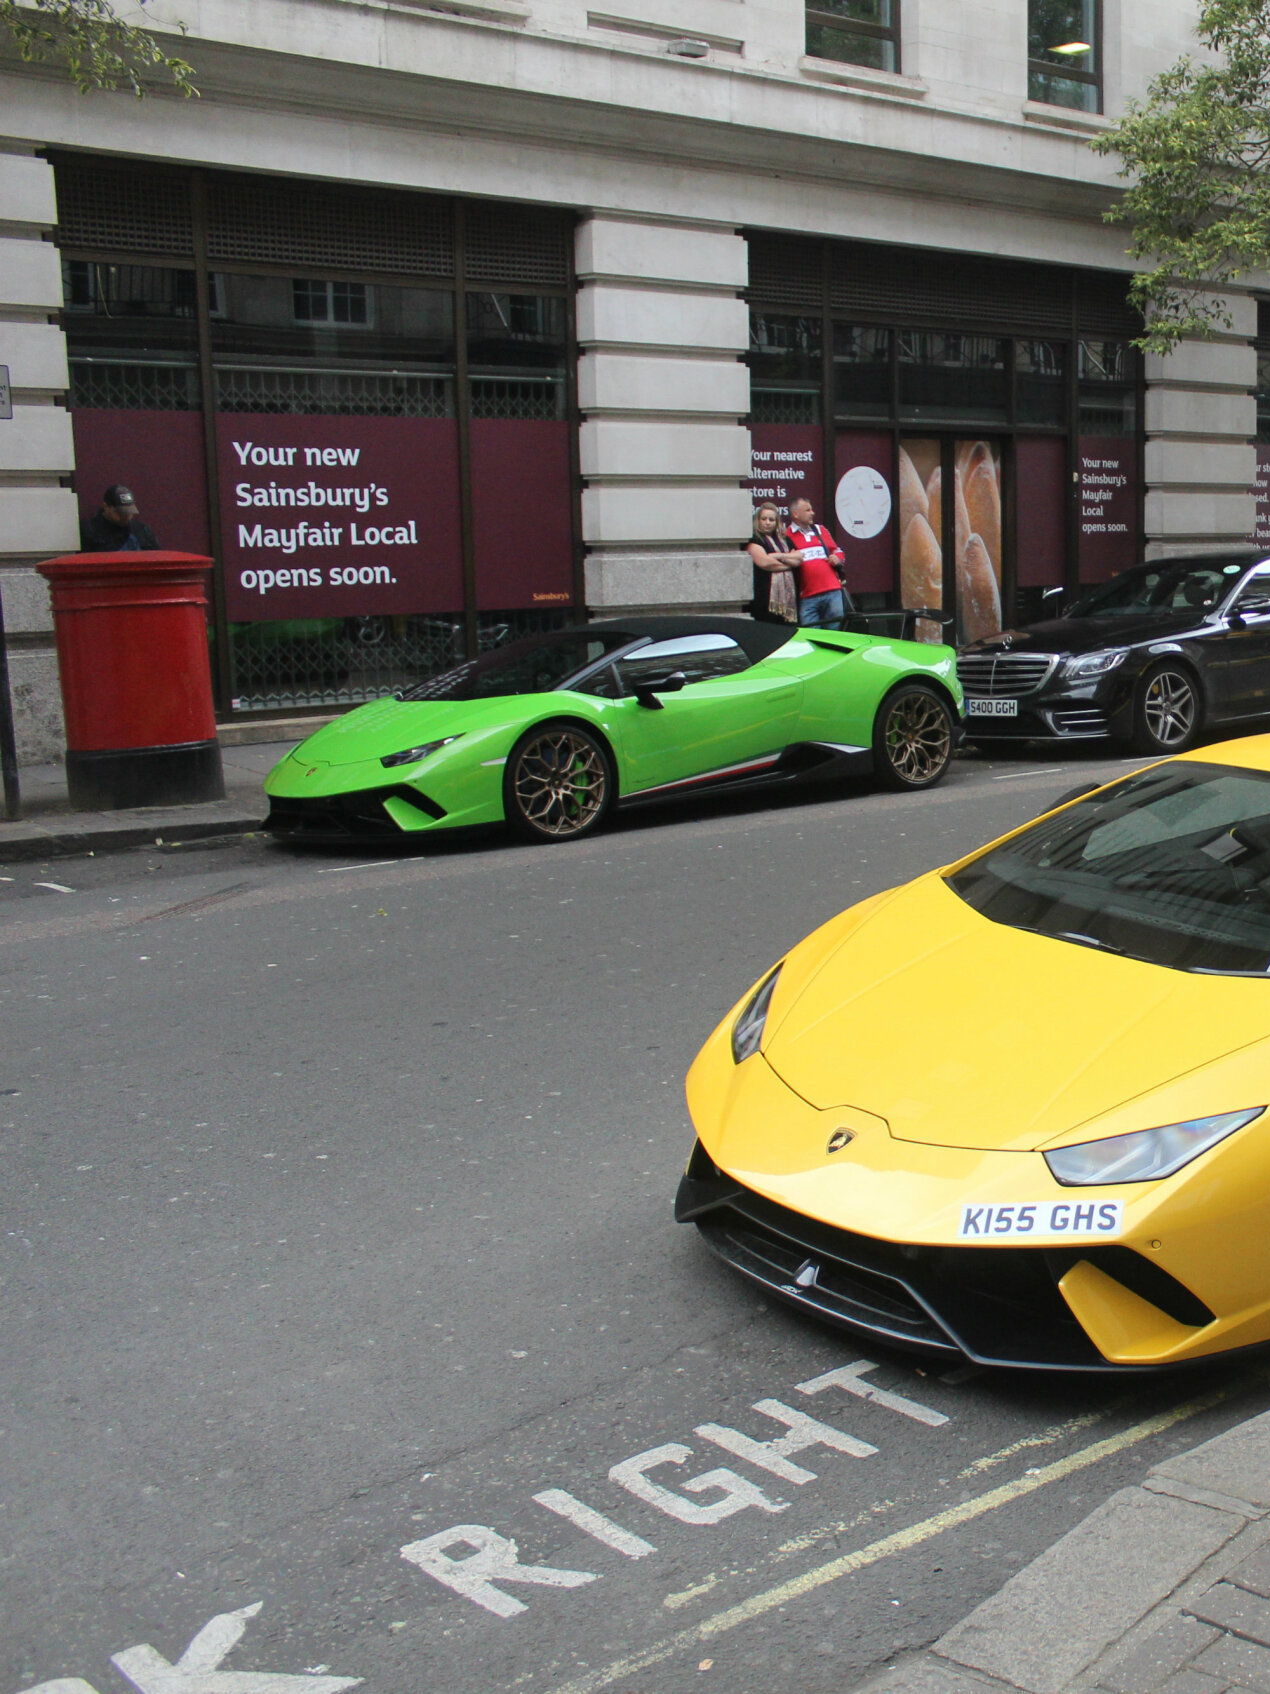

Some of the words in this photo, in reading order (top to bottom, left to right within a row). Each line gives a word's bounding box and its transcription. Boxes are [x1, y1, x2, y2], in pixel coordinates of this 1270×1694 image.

[232, 441, 297, 466] Your
[304, 446, 360, 466] new
[774, 450, 813, 461] nearest
[1082, 457, 1101, 469] Your
[1102, 459, 1119, 469] new
[748, 467, 805, 479] alternative
[1082, 473, 1127, 487] Sainsbury's
[235, 481, 389, 512] Sainsbury's
[777, 485, 787, 498] is
[1082, 489, 1113, 502] Mayfair
[1082, 505, 1104, 516] Local
[1082, 522, 1106, 534] opens
[1107, 522, 1129, 532] soon.
[238, 521, 343, 553] Mayfair
[350, 520, 418, 545] Local
[240, 567, 322, 594] opens
[329, 565, 397, 586] soon.
[970, 701, 993, 713] S400
[995, 701, 1016, 714] GGH
[962, 1204, 1037, 1235] K155
[1050, 1203, 1118, 1231] GHS
[400, 1359, 950, 1617] RIGHT
